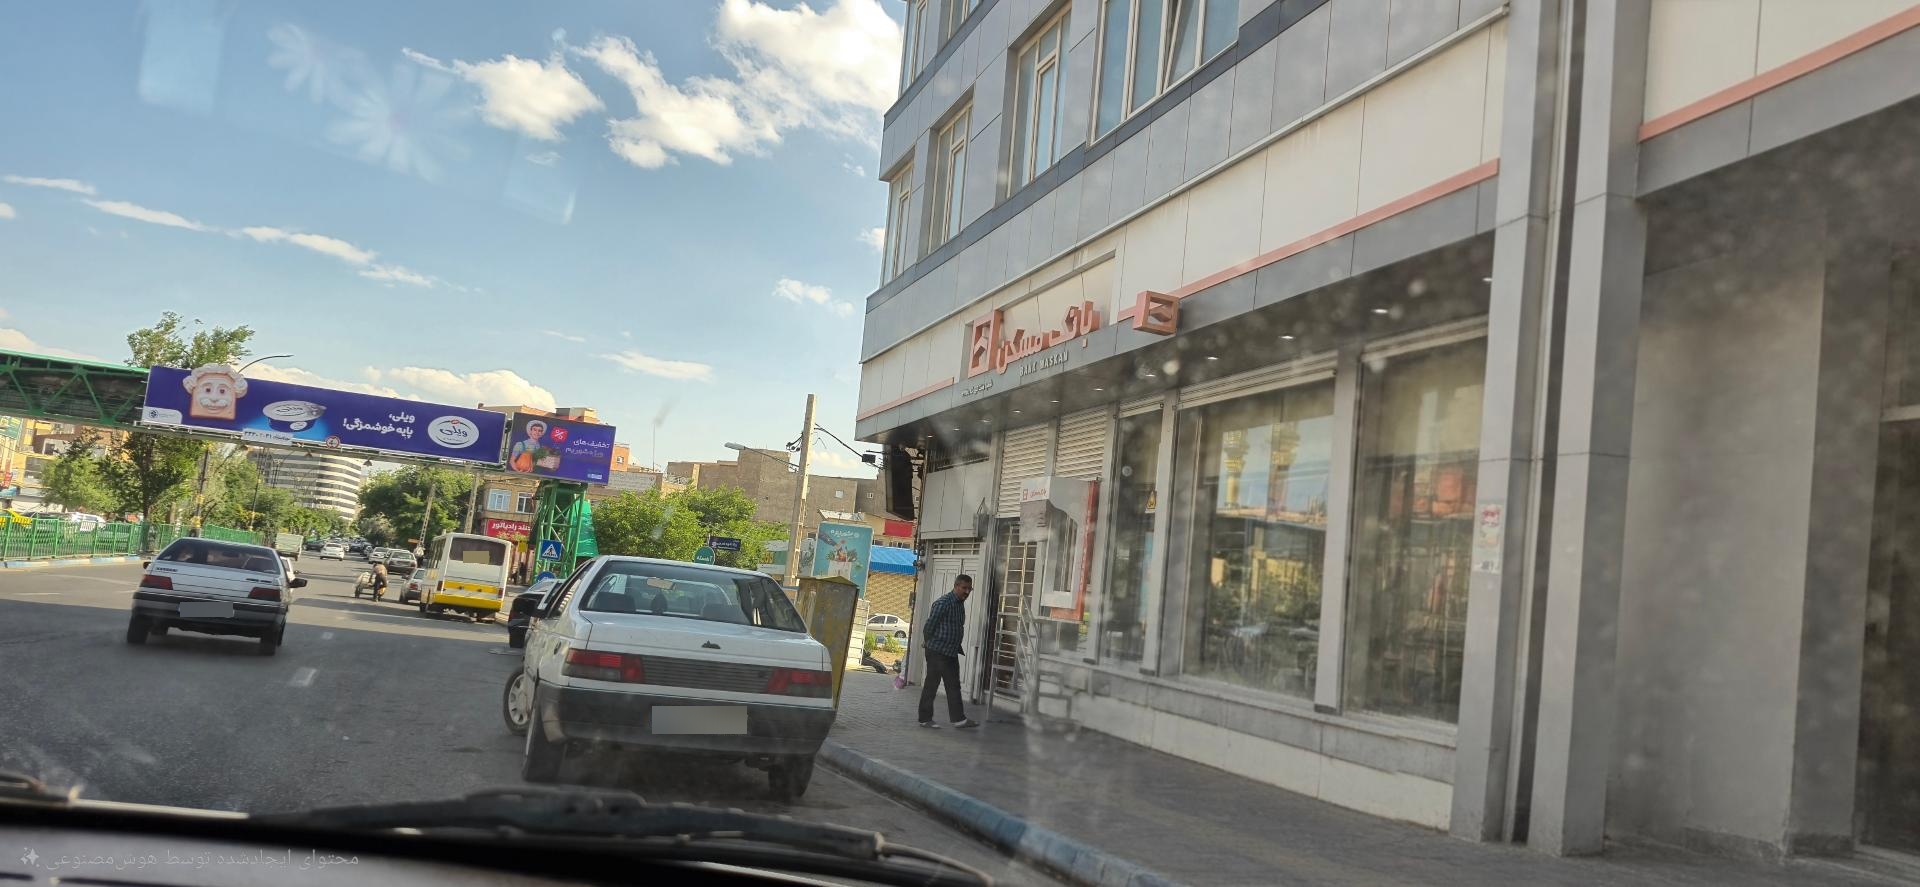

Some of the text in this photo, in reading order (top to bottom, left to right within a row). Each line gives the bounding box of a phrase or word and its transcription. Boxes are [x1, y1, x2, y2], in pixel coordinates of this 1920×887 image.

[997, 300, 1101, 374] بانک مسکن
[1019, 350, 1069, 377] BANK MASKAN
[388, 412, 416, 424] ویلی،
[342, 417, 414, 440] پایه خوشمزگی!
[439, 425, 468, 438] ویلی
[491, 521, 517, 531] رادیاتور
